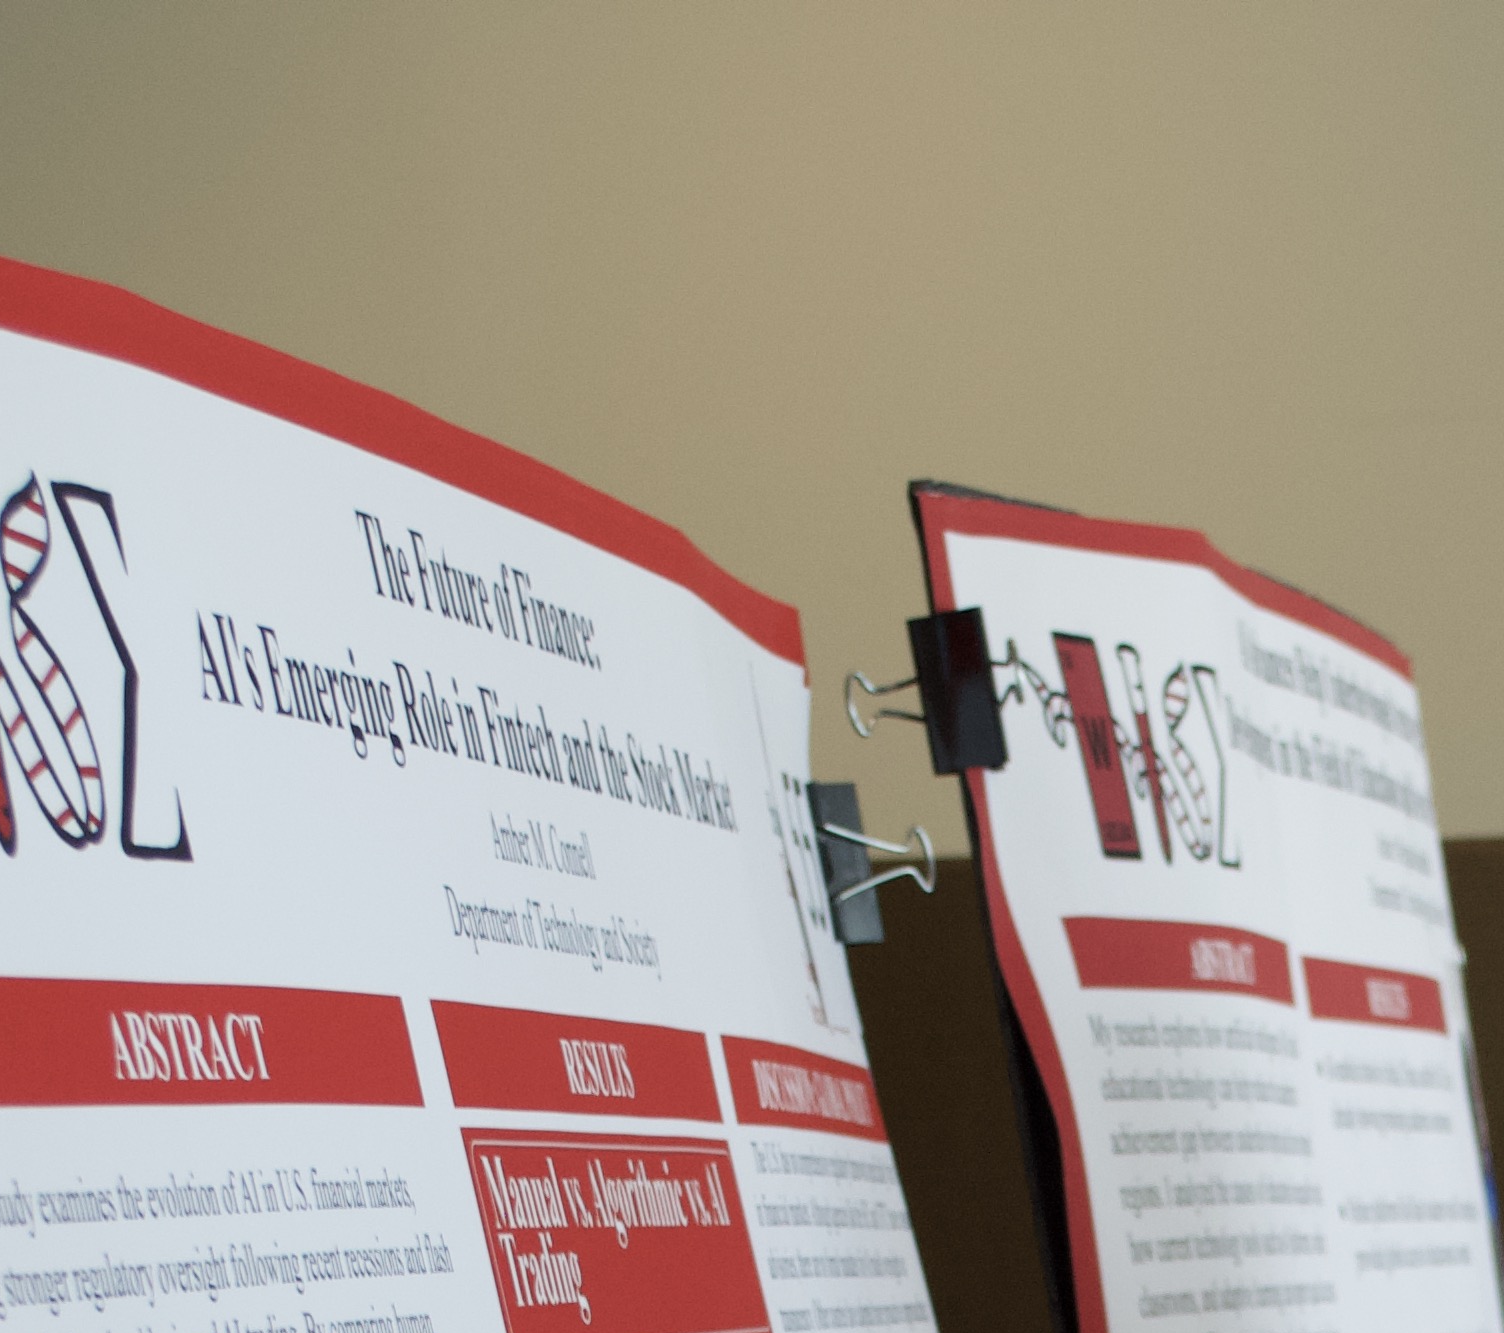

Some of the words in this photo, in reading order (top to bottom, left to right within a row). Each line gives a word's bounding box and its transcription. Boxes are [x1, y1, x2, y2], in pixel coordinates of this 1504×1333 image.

[353, 509, 415, 607] The
[406, 528, 494, 633] Future
[492, 562, 520, 642] of
[509, 566, 602, 670] Finance:
[196, 612, 264, 712] AI's
[256, 624, 405, 768] Emerging
[391, 660, 458, 757] Role
[450, 676, 486, 764] in
[476, 685, 564, 784] Fintech
[561, 718, 603, 795] and
[597, 724, 633, 804] the
[625, 731, 683, 817] Stock
[671, 747, 738, 833] Market
[442, 883, 524, 955] Department
[520, 896, 539, 950] of
[530, 899, 603, 973] Technology
[599, 914, 625, 963] and
[616, 915, 662, 981] Society
[109, 1010, 270, 1082] ABSTRACT
[558, 1037, 635, 1099] RESULTS
[479, 1154, 568, 1231] Manual
[560, 1176, 594, 1228] vs.
[586, 1157, 689, 1249] Algorithmic
[682, 1178, 713, 1227] vs.
[704, 1161, 731, 1226] AI
[496, 1230, 592, 1325] Trading
